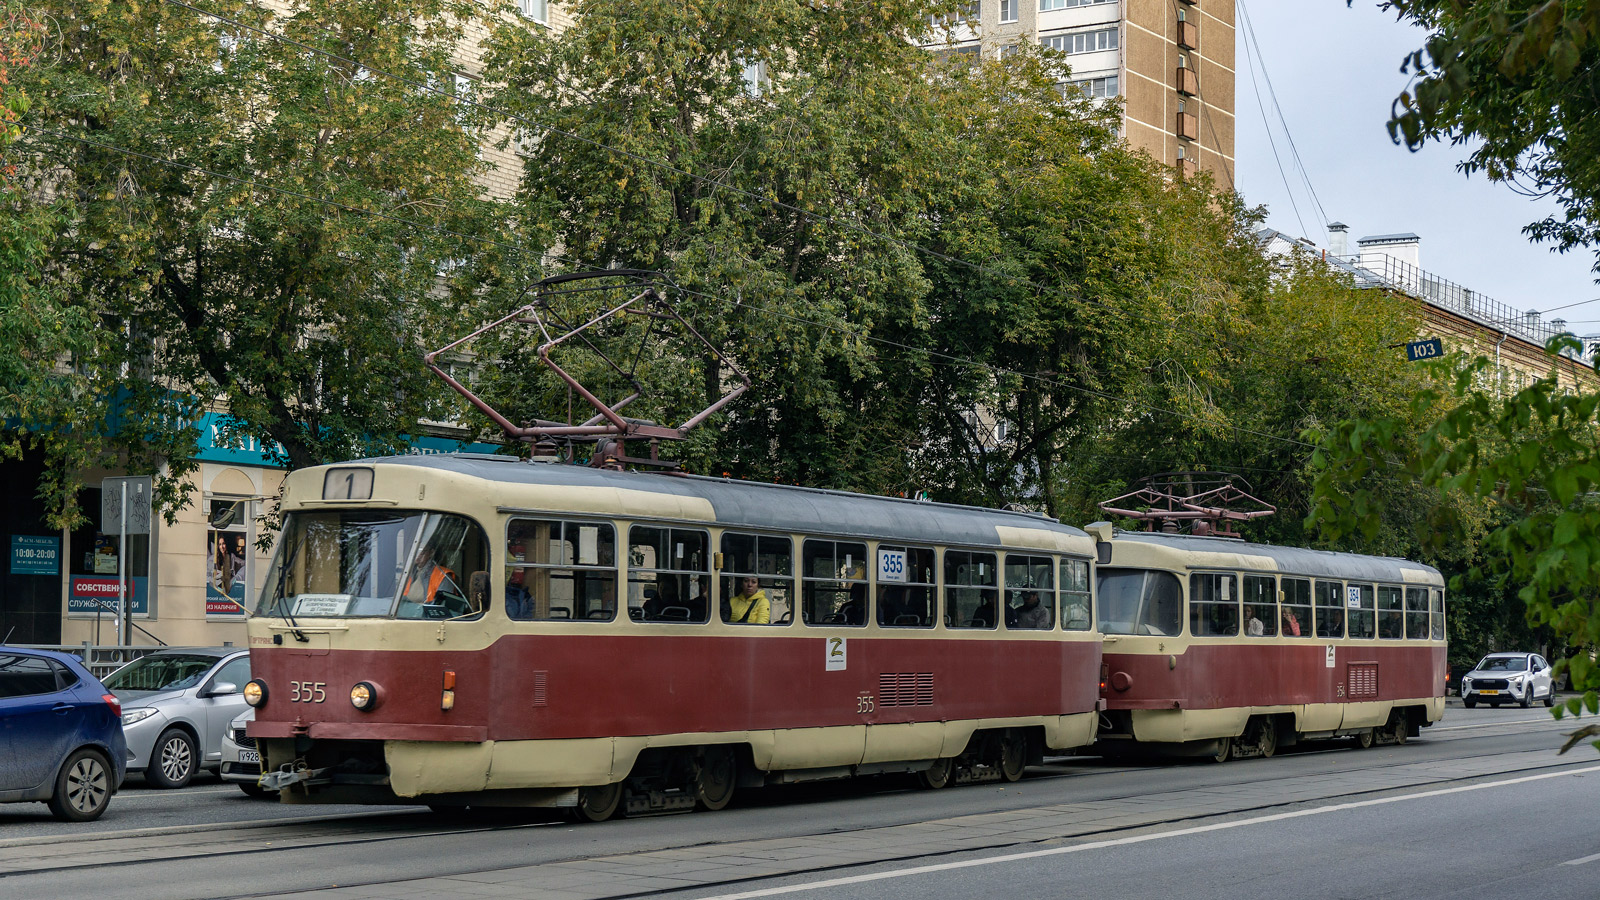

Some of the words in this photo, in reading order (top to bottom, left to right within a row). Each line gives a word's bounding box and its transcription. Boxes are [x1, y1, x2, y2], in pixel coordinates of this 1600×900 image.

[345, 472, 354, 500] 1
[15, 548, 56, 559] 10:00-20:00
[883, 553, 903, 574] 355
[1349, 588, 1359, 602] 354
[290, 680, 327, 703] 355
[856, 696, 875, 714] 355
